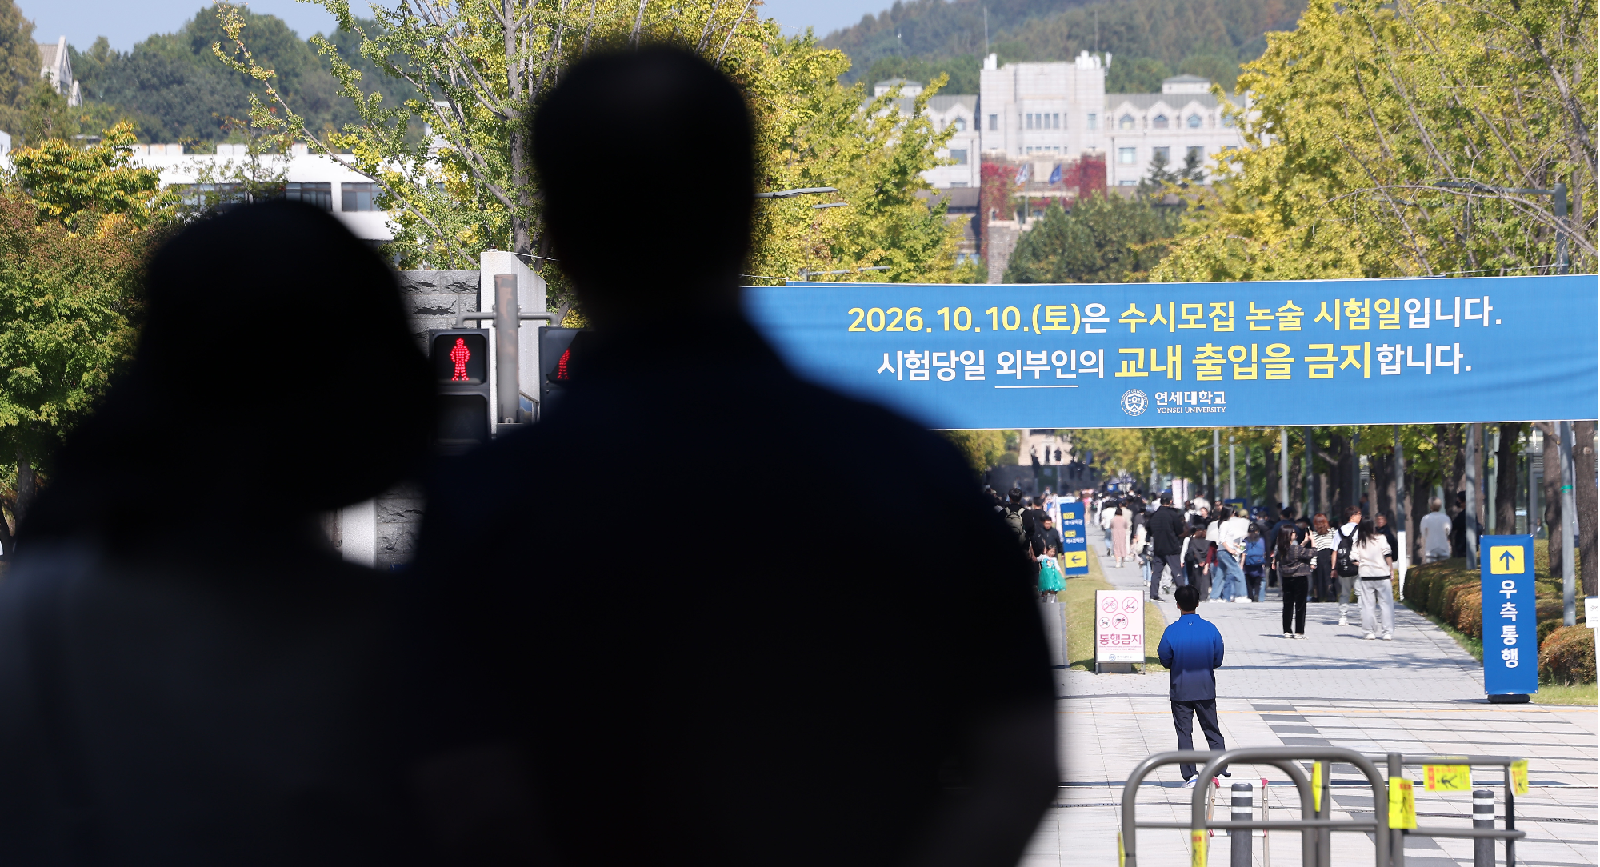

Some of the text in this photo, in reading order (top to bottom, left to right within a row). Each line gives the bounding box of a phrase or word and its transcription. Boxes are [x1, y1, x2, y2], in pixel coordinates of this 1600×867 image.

[1119, 301, 1234, 333] 수시모집
[1246, 300, 1304, 331] 논술
[1314, 296, 1501, 330] 시험일입니다.
[877, 342, 1471, 381] 시험당일 외부인의 교내 출입을 금지합니다.
[1154, 390, 1227, 405] 연세대학교
[1157, 406, 1183, 414] YONSEI
[1499, 581, 1519, 669] 우측통행
